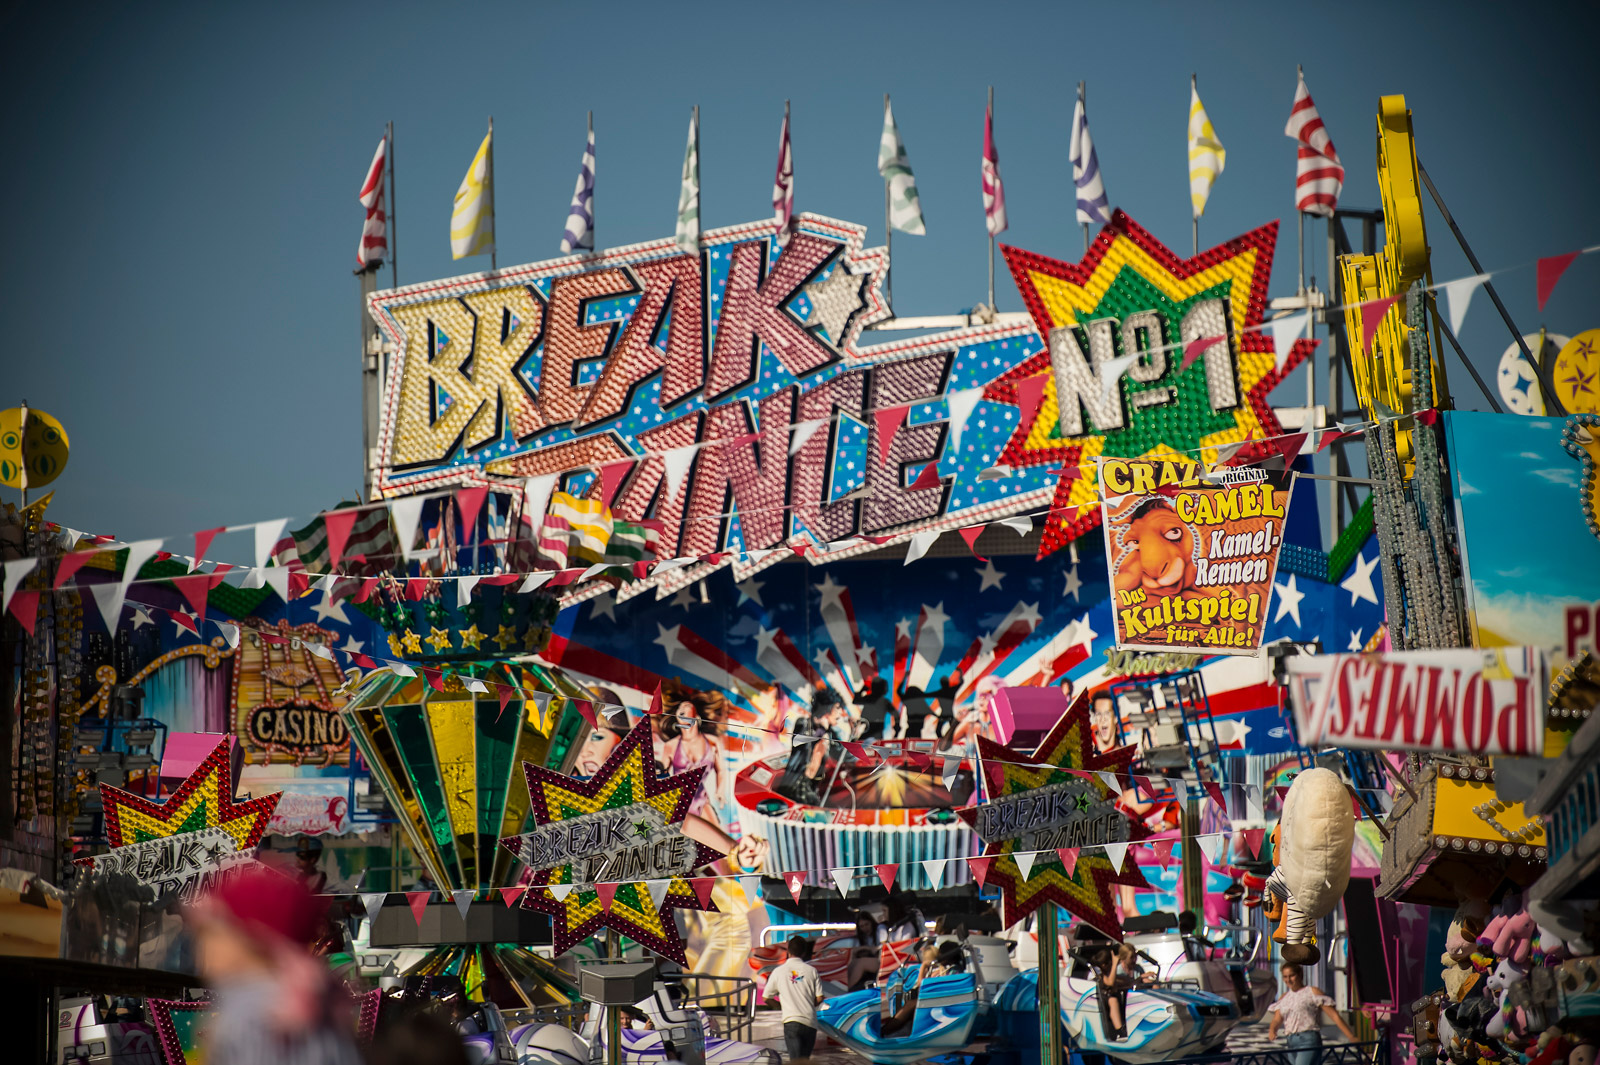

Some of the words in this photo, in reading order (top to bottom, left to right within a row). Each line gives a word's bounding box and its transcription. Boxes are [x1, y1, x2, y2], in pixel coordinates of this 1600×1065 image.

[390, 228, 848, 470] BREAK
[1176, 484, 1285, 525] CAMEL
[1208, 520, 1281, 560] Kamel-
[1195, 558, 1268, 586] Rennen
[1117, 587, 1147, 606] Das
[1120, 590, 1261, 638] Kultspiel
[1166, 625, 1199, 644] für
[1204, 627, 1254, 647] Alle!
[256, 704, 344, 746] CASINO
[1329, 657, 1529, 756] POMMES
[982, 790, 1071, 840] BREAK
[1031, 813, 1121, 855] DANCE
[527, 817, 631, 867] BREAK
[581, 836, 687, 884] DANCE
